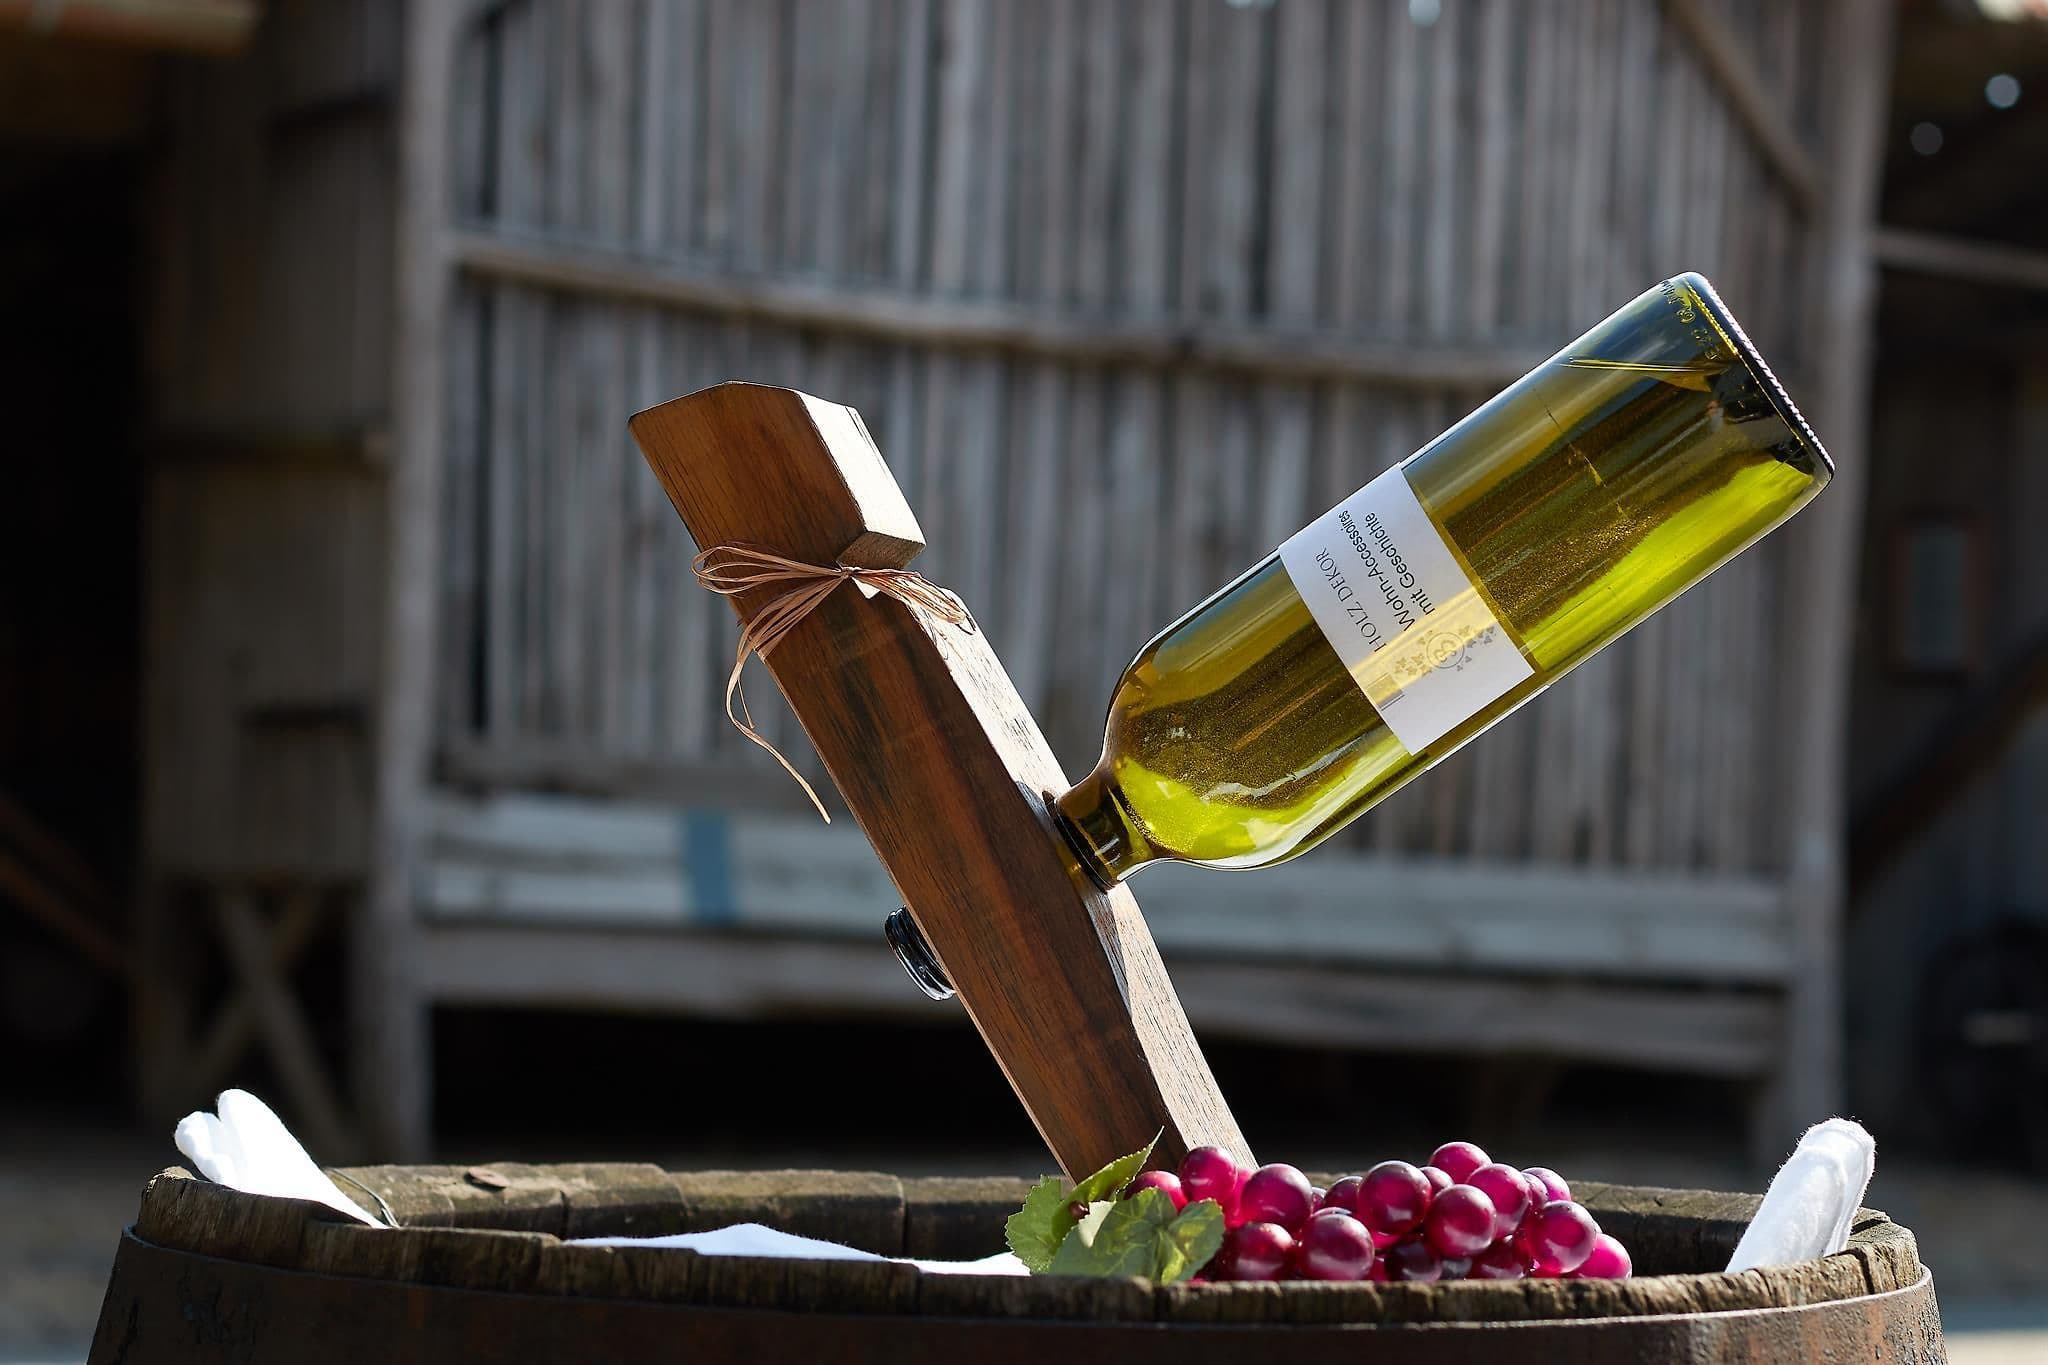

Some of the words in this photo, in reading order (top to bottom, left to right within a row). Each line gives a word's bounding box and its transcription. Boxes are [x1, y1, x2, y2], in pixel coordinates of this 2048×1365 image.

[1315, 547, 1353, 602] DEKOR
[1338, 510, 1416, 631] Wohn-Accessoires
[1365, 512, 1416, 589] Geschichte
[1347, 601, 1387, 653] HOLZ
[1410, 587, 1436, 616] mit
